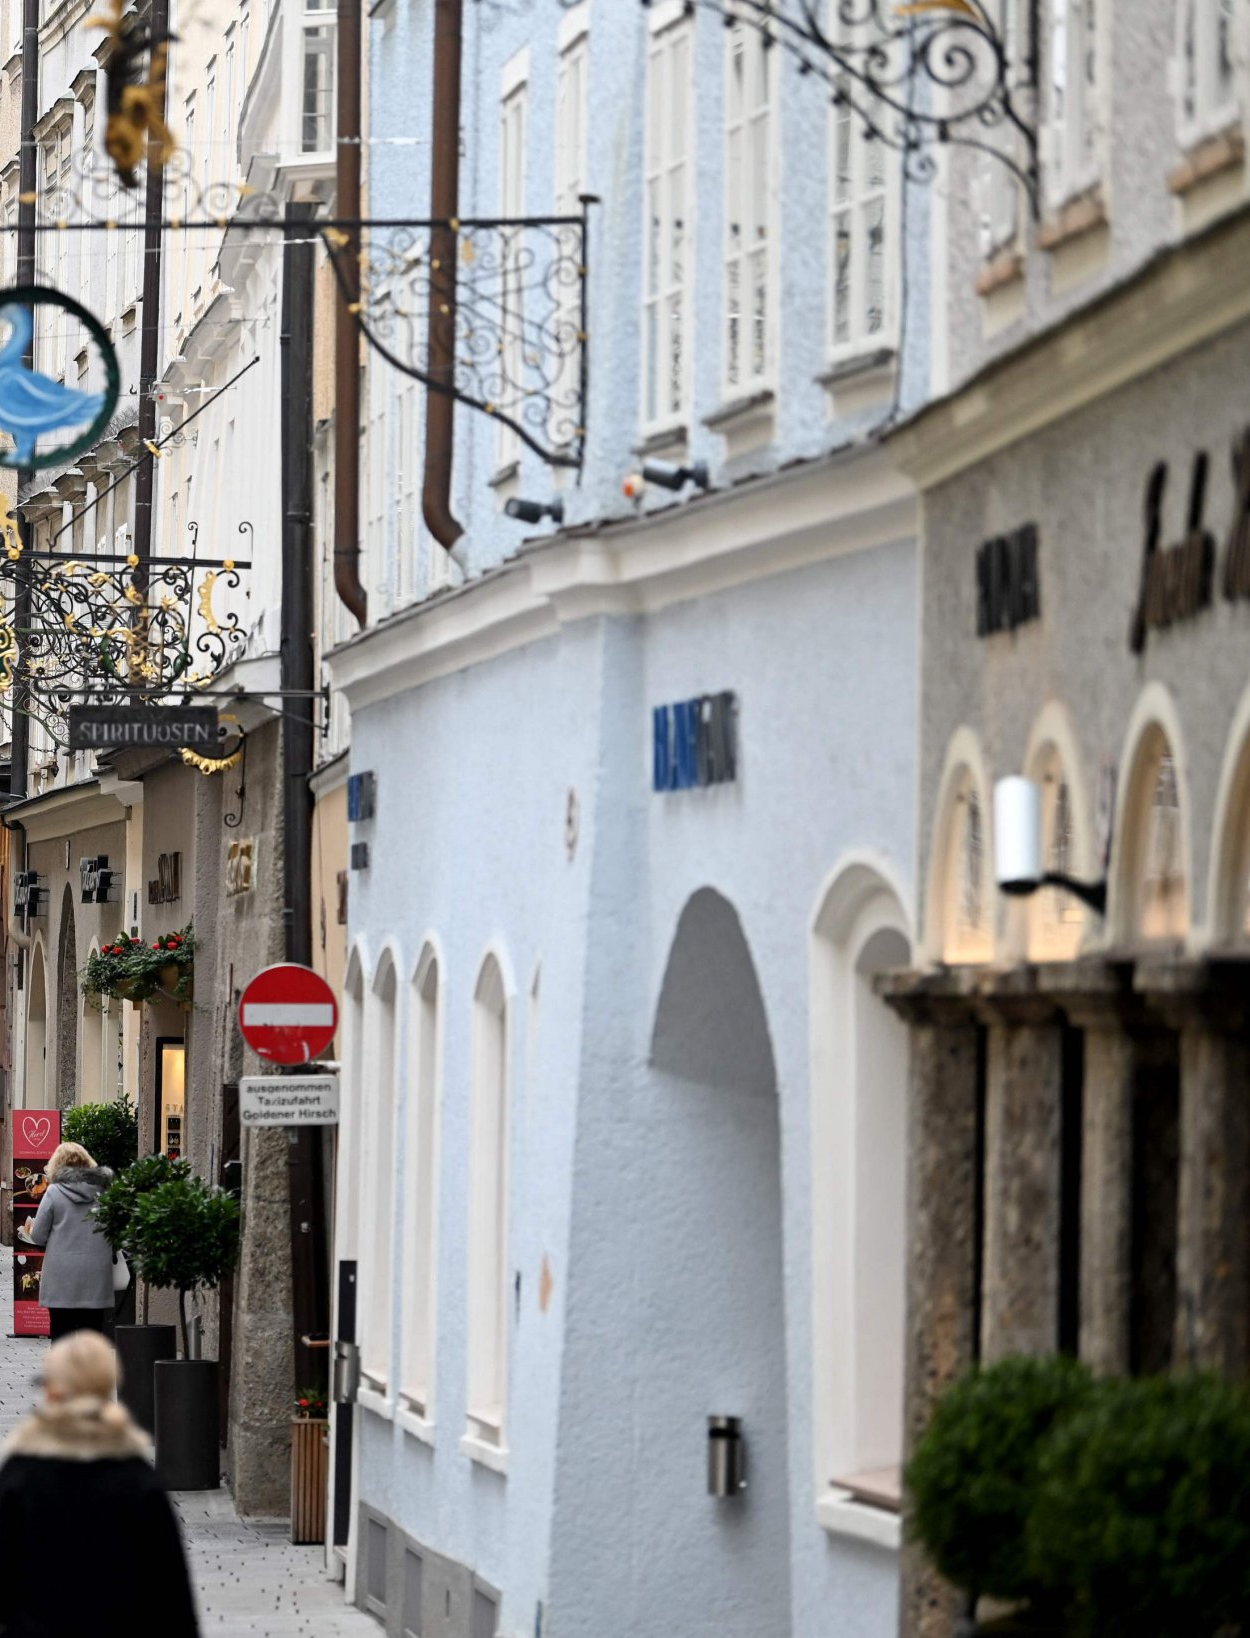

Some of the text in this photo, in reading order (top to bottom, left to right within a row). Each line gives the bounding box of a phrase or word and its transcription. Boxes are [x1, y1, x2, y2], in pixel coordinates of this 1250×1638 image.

[79, 722, 210, 743] SPIRITUOSEN
[246, 1083, 332, 1095] ausgenommen
[256, 1096, 322, 1106] Taxizufahrt
[242, 1108, 337, 1121] Goldener Hirsch
